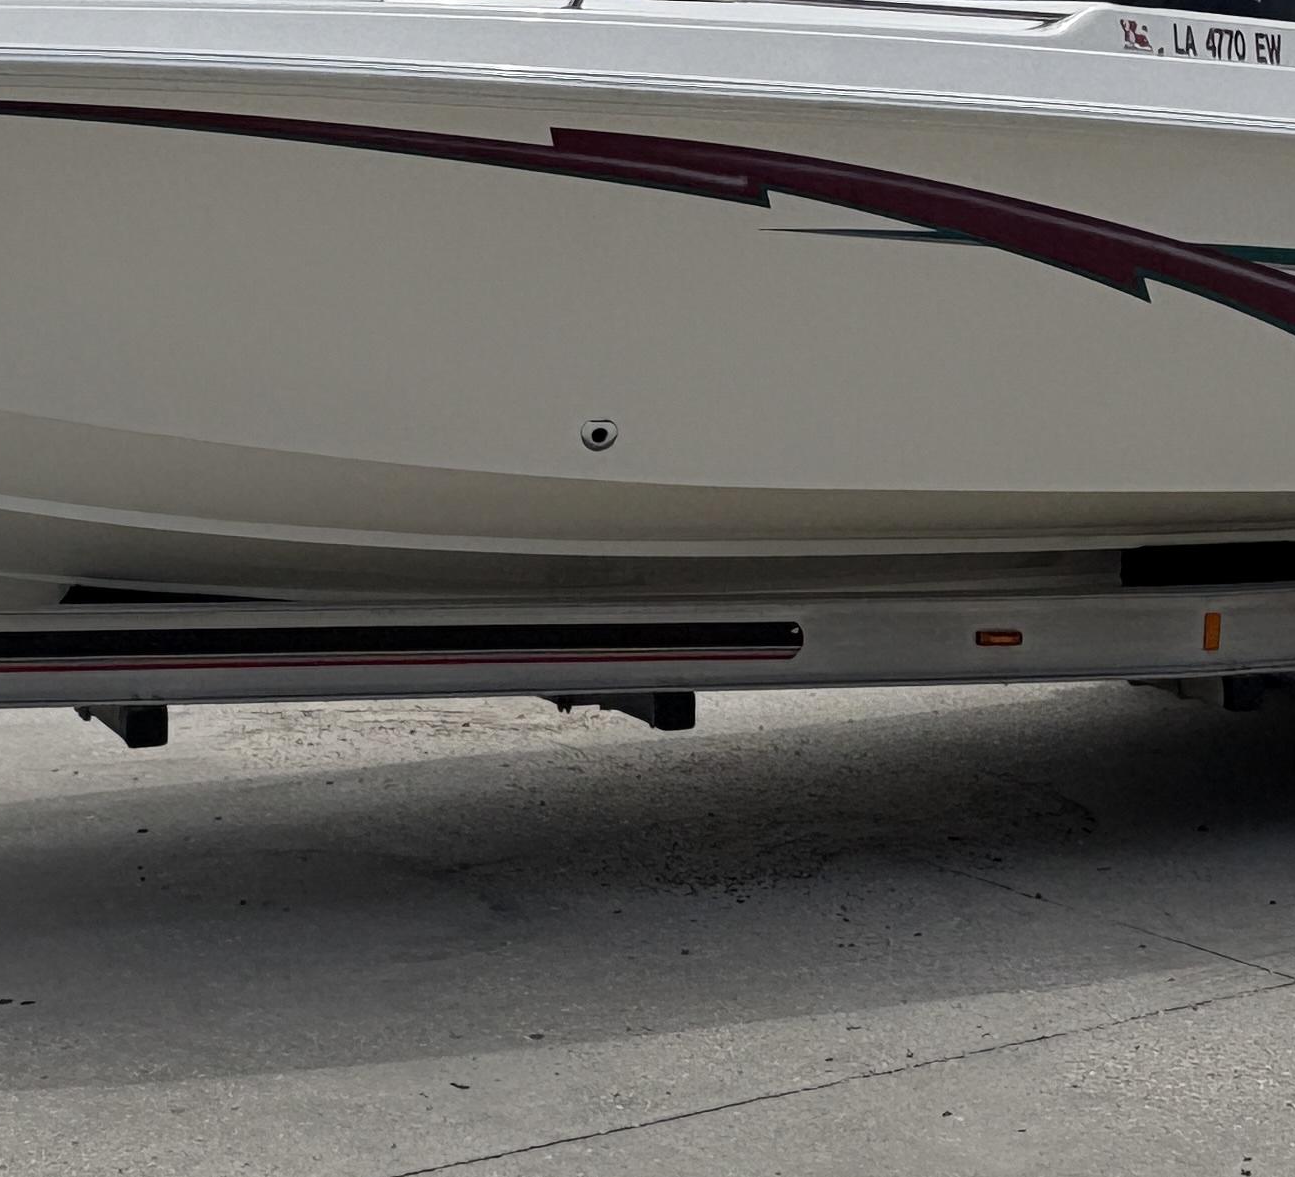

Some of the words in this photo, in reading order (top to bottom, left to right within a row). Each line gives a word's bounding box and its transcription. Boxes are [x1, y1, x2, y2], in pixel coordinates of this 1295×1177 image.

[1173, 23, 1197, 56] LA
[1206, 27, 1246, 61] 4770
[1255, 32, 1282, 64] EW
